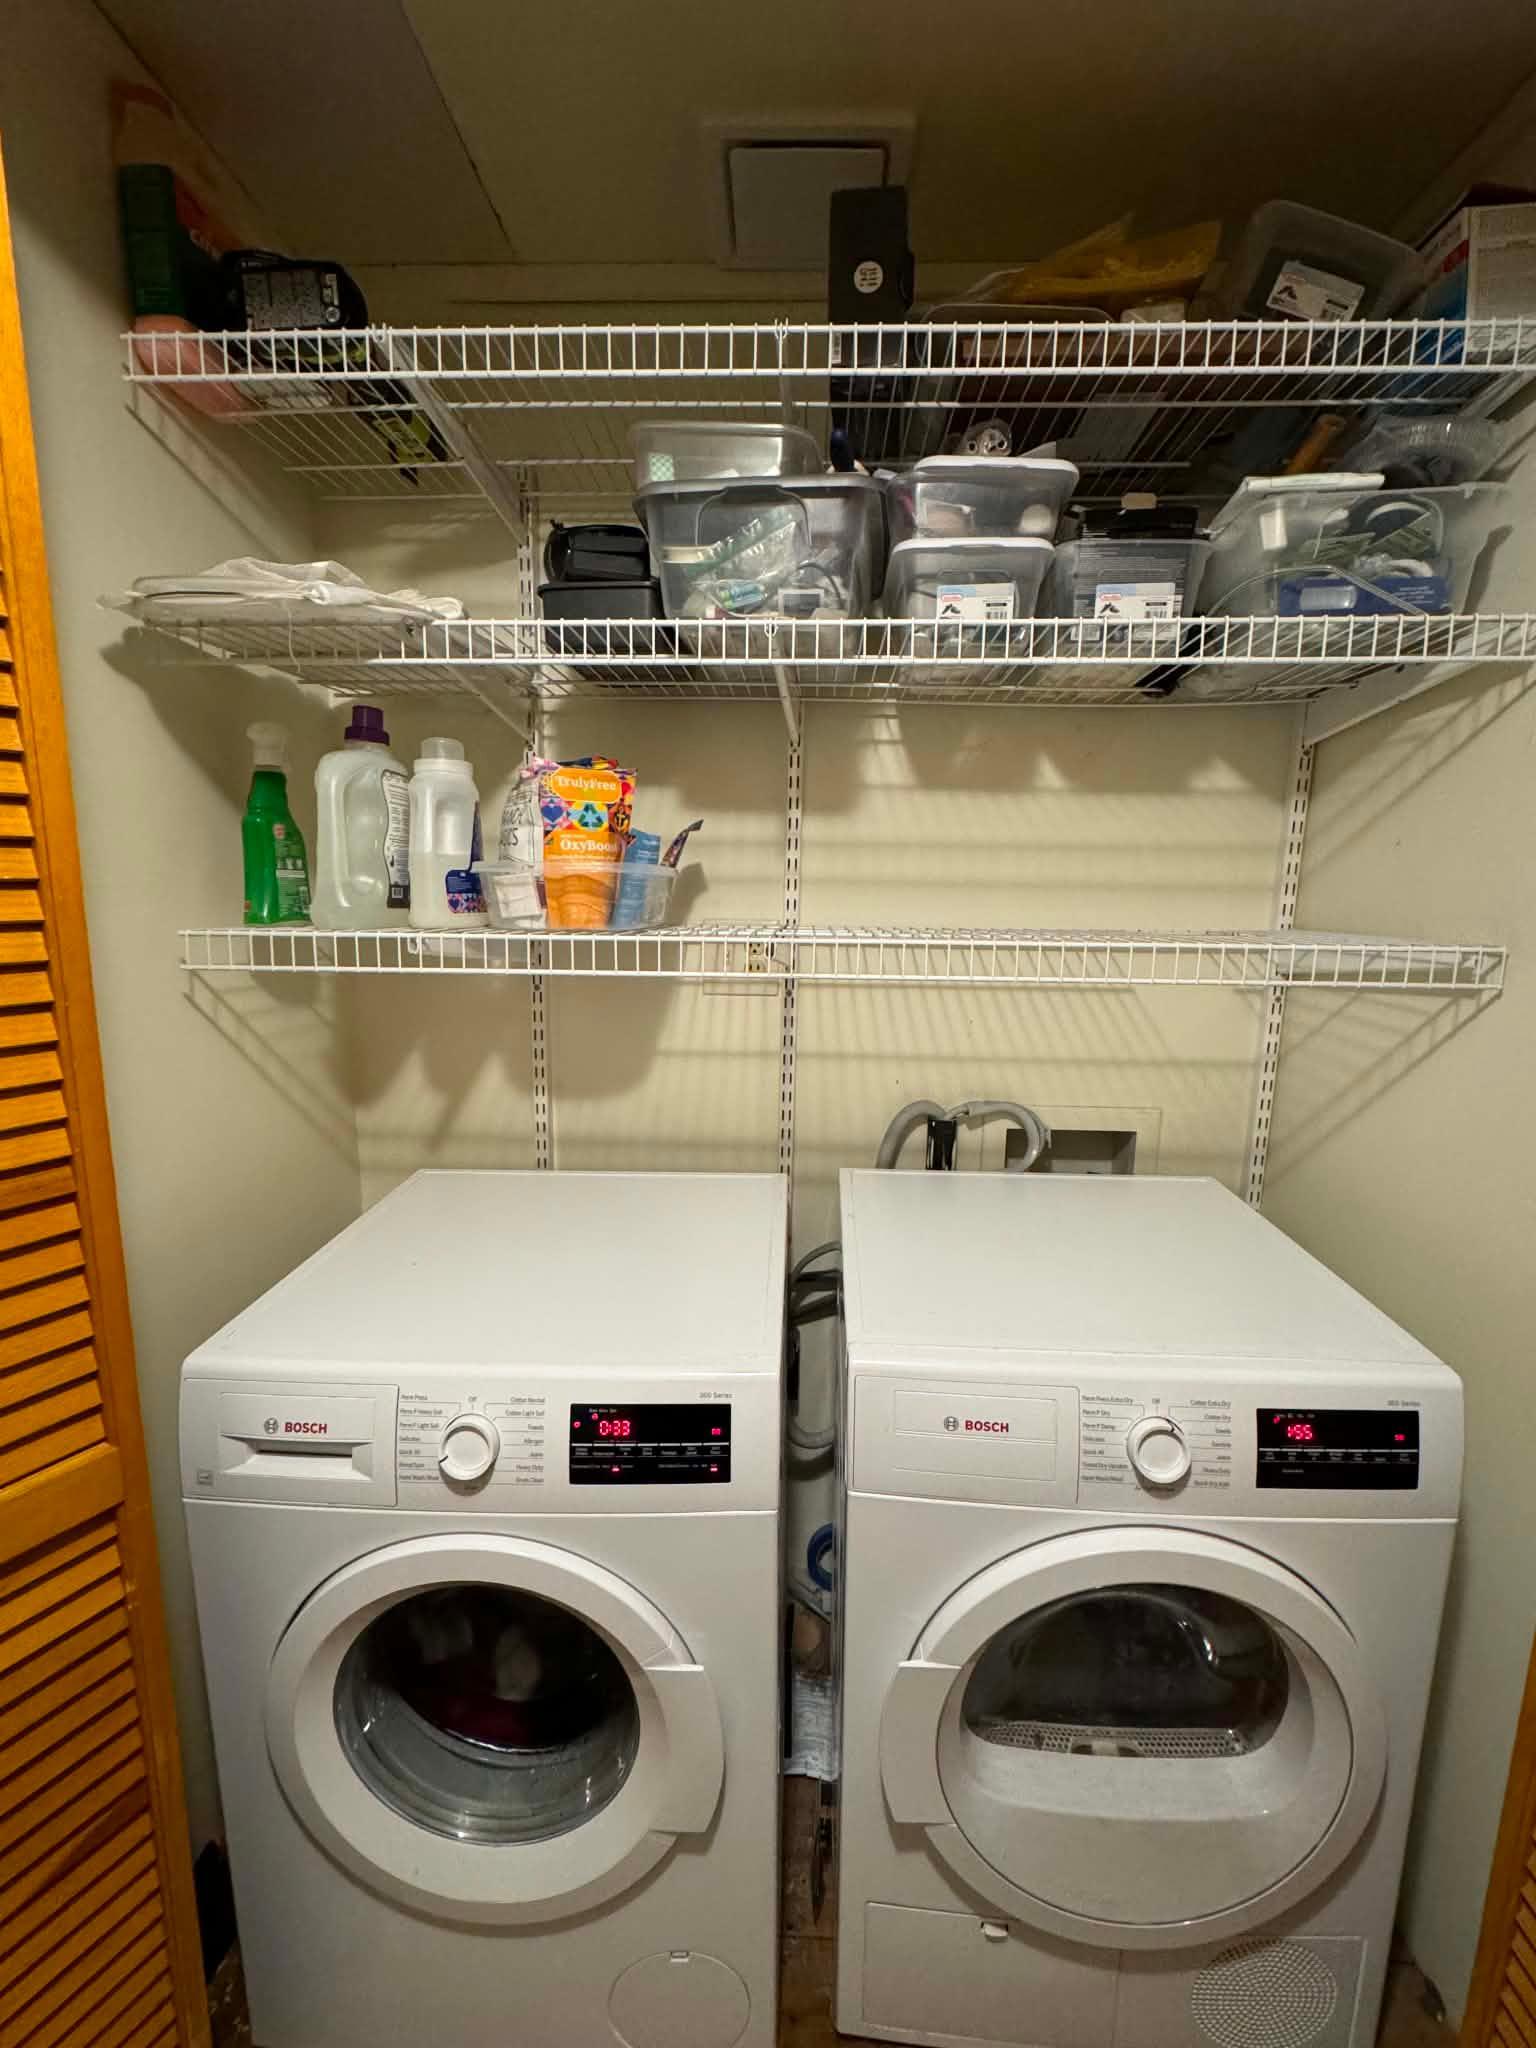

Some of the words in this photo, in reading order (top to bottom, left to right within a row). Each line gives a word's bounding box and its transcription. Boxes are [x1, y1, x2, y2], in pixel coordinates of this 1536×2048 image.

[559, 776, 616, 791] TrulyFree
[285, 1422, 327, 1433] BOSCH
[965, 1420, 1009, 1432] BOSCH
